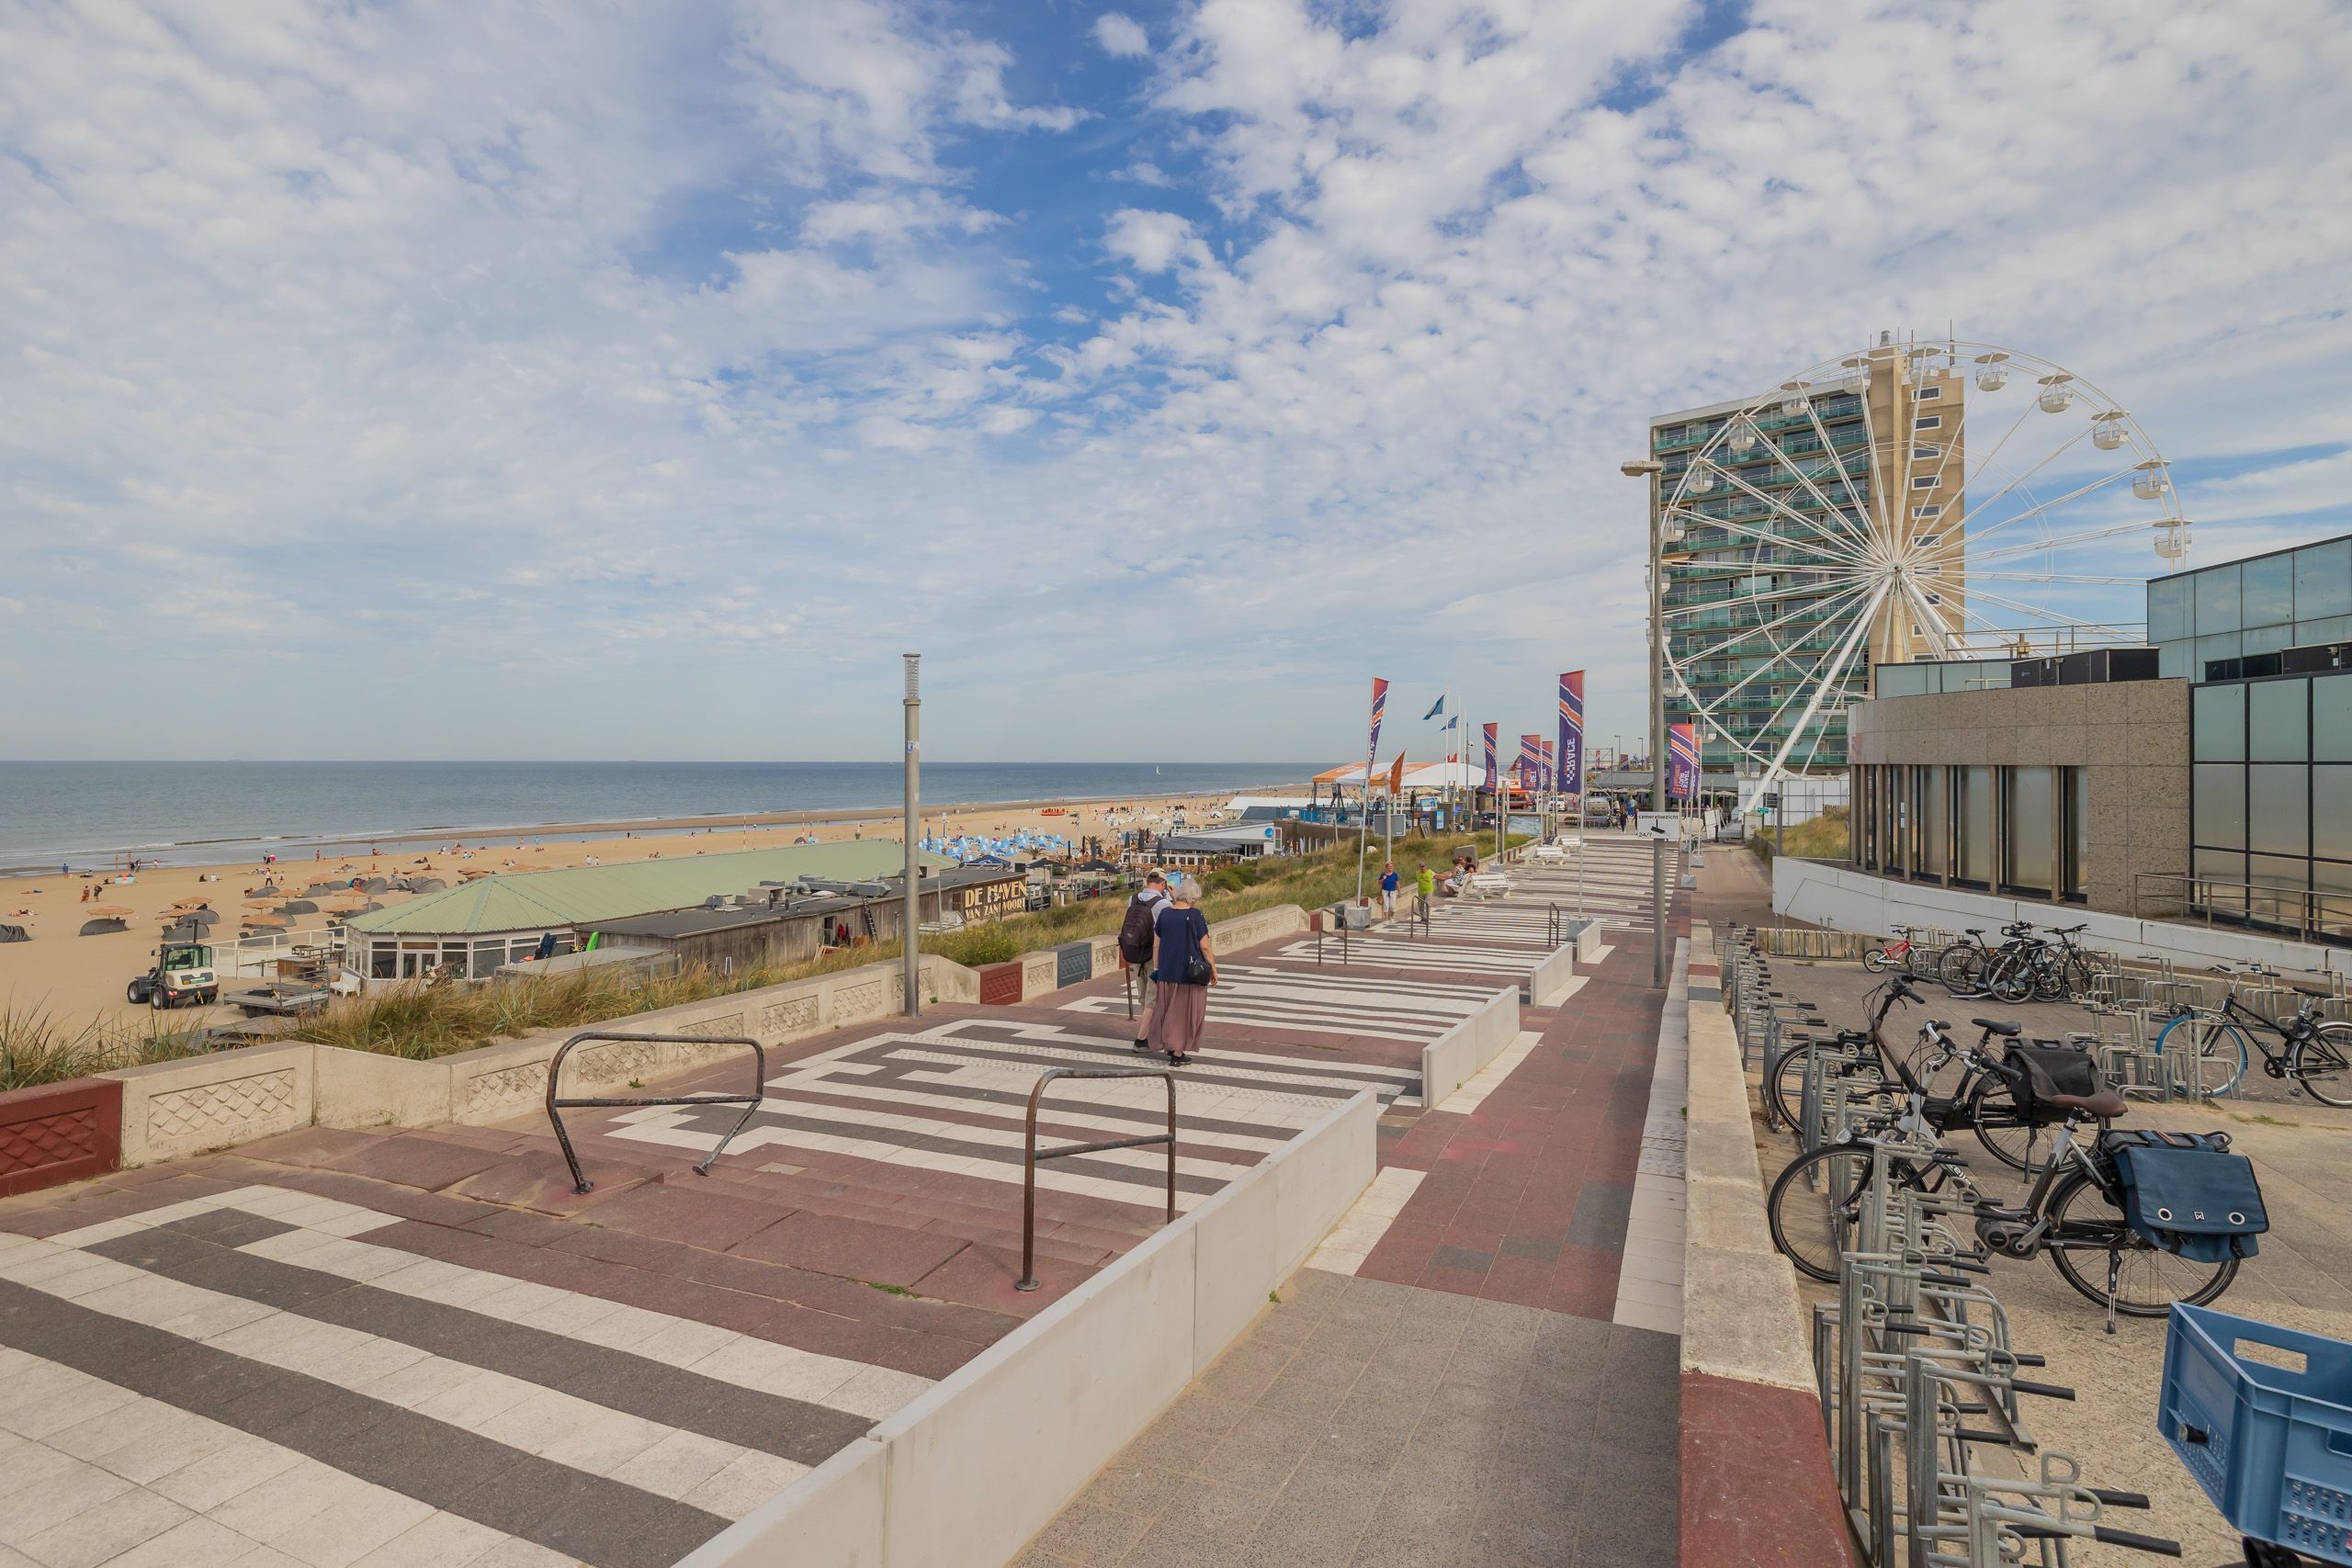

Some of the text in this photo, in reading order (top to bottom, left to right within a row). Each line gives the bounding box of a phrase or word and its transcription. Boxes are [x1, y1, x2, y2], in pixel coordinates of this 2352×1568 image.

[965, 880, 1027, 908] DE HAVEN
[965, 908, 980, 920] VAN
